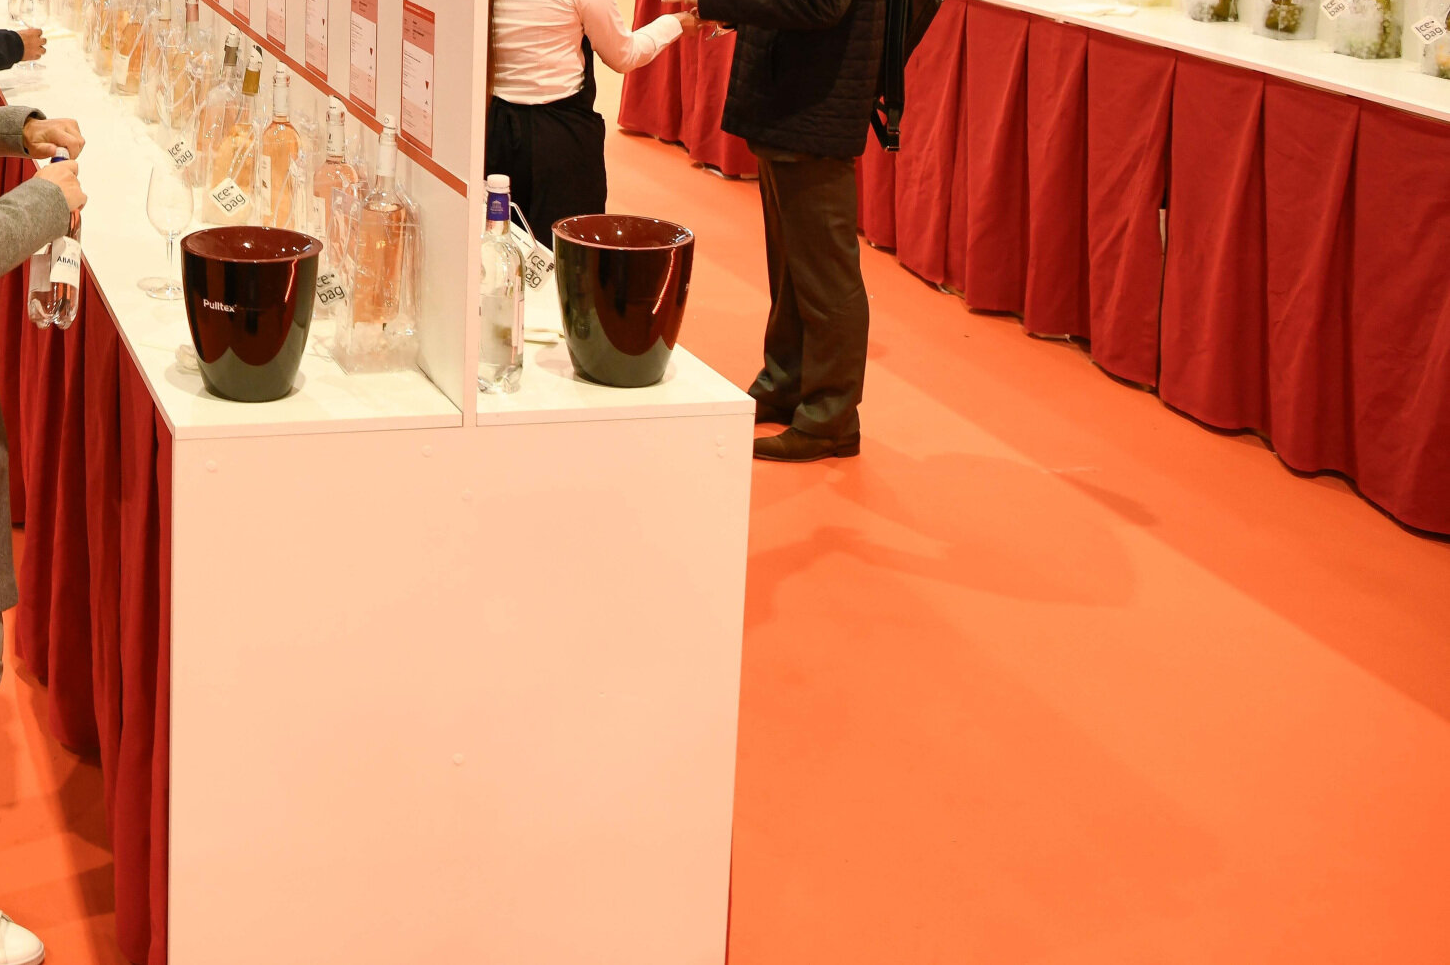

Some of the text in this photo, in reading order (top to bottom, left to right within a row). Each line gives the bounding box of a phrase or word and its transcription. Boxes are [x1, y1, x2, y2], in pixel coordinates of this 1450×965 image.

[1323, 0, 1337, 10] Ice
[1329, 2, 1346, 17] bag
[1415, 21, 1432, 34] Ice
[1422, 25, 1444, 41] bag
[167, 142, 182, 158] Ice
[212, 188, 231, 203] Ice
[221, 193, 246, 212] bag
[527, 250, 546, 271] Ice
[525, 265, 542, 288] ag
[317, 284, 345, 304] bag
[203, 298, 236, 313] Pulltex
